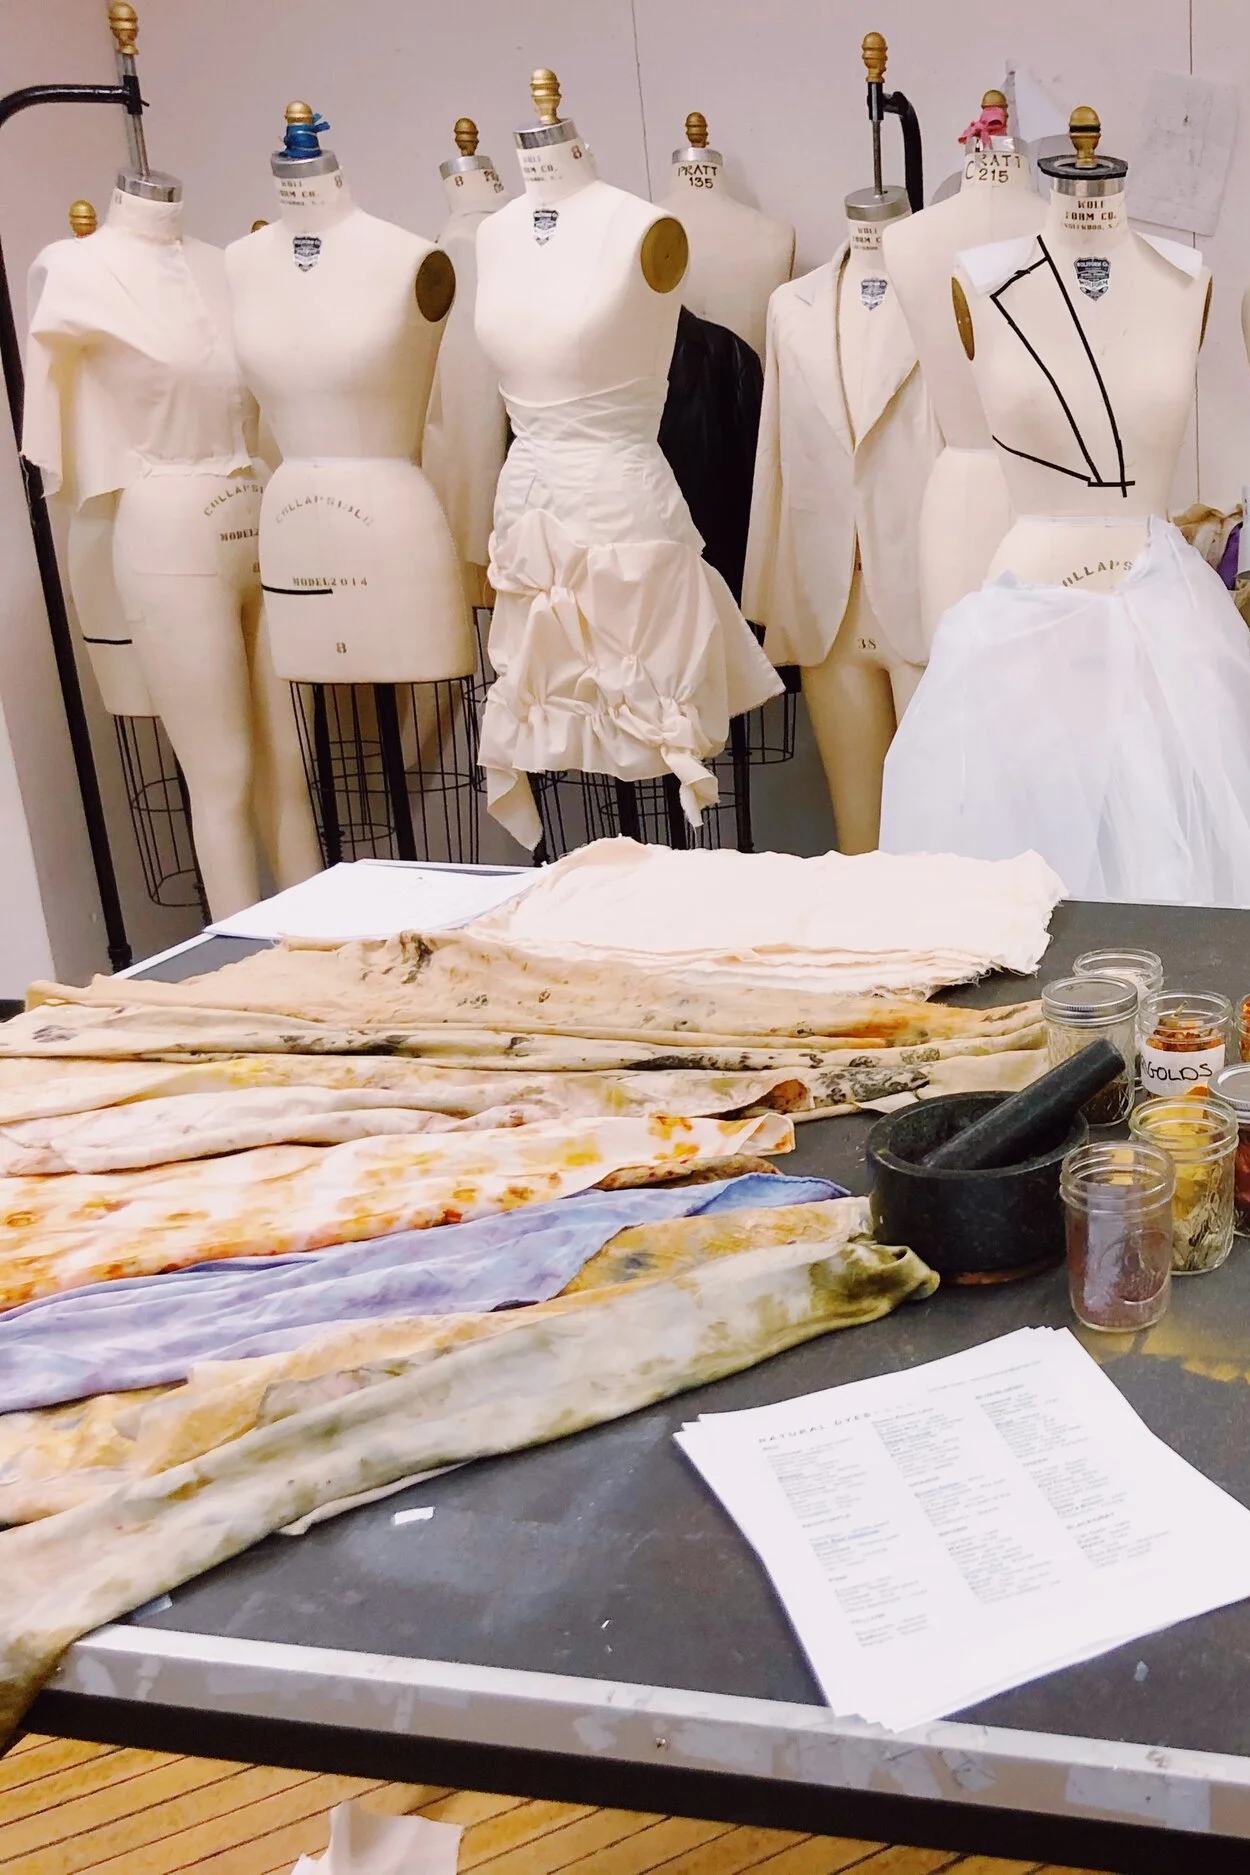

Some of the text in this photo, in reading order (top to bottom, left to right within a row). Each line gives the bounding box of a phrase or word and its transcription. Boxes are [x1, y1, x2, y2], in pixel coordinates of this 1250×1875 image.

[677, 164, 718, 177] PRATT
[979, 167, 1009, 184] 215
[688, 176, 714, 189] 135
